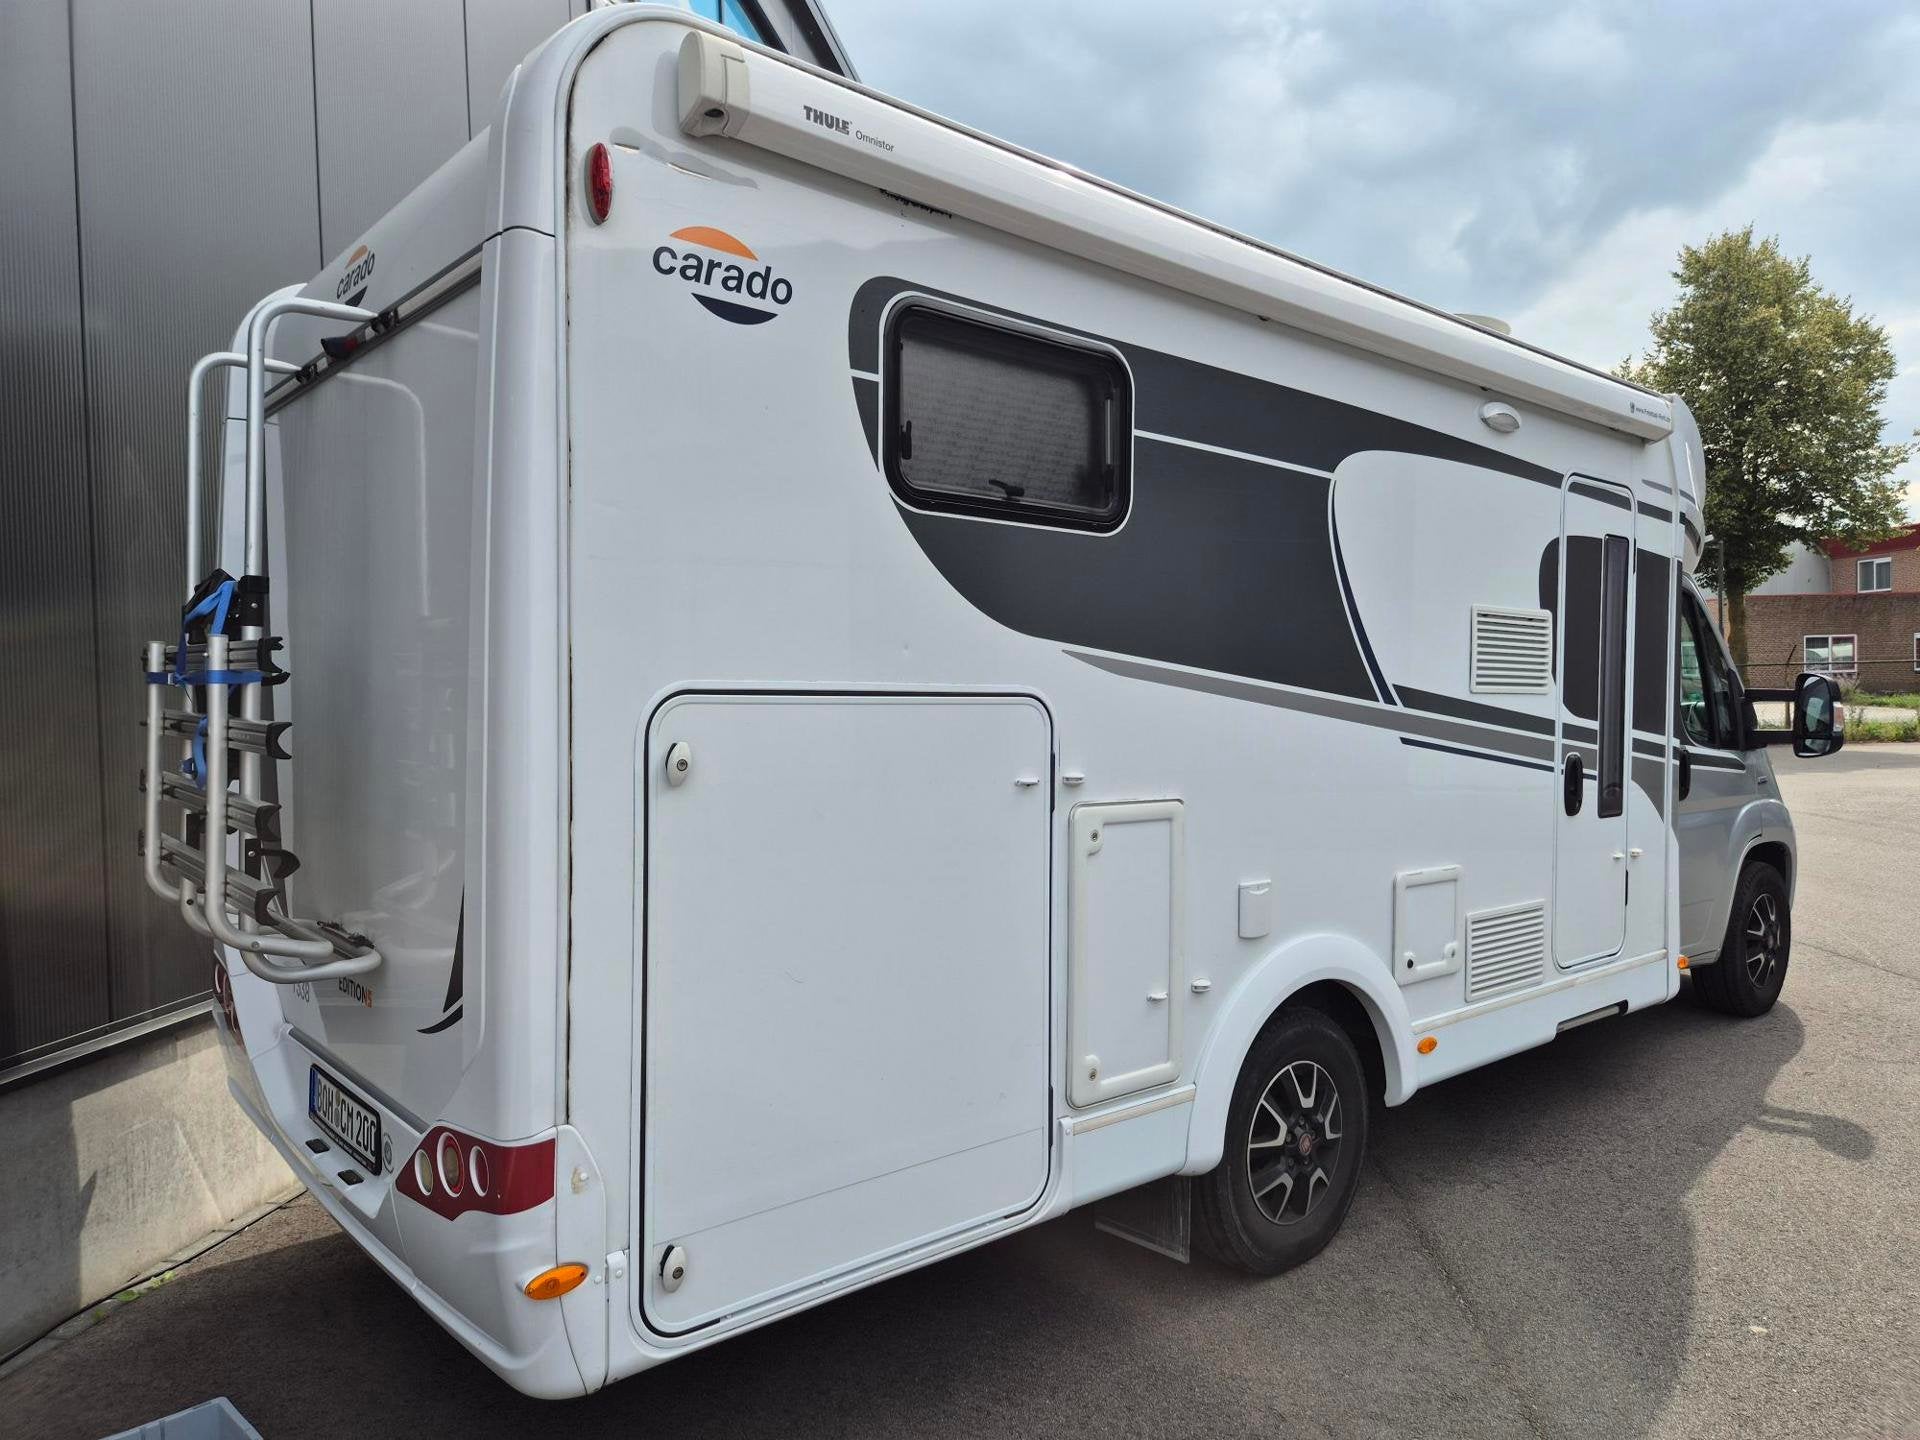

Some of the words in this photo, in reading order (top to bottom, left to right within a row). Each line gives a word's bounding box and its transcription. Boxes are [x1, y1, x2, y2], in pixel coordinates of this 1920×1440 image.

[803, 105, 850, 136] THULE
[855, 130, 895, 152] Omnistor
[336, 250, 376, 300] carado
[652, 246, 793, 305] carado
